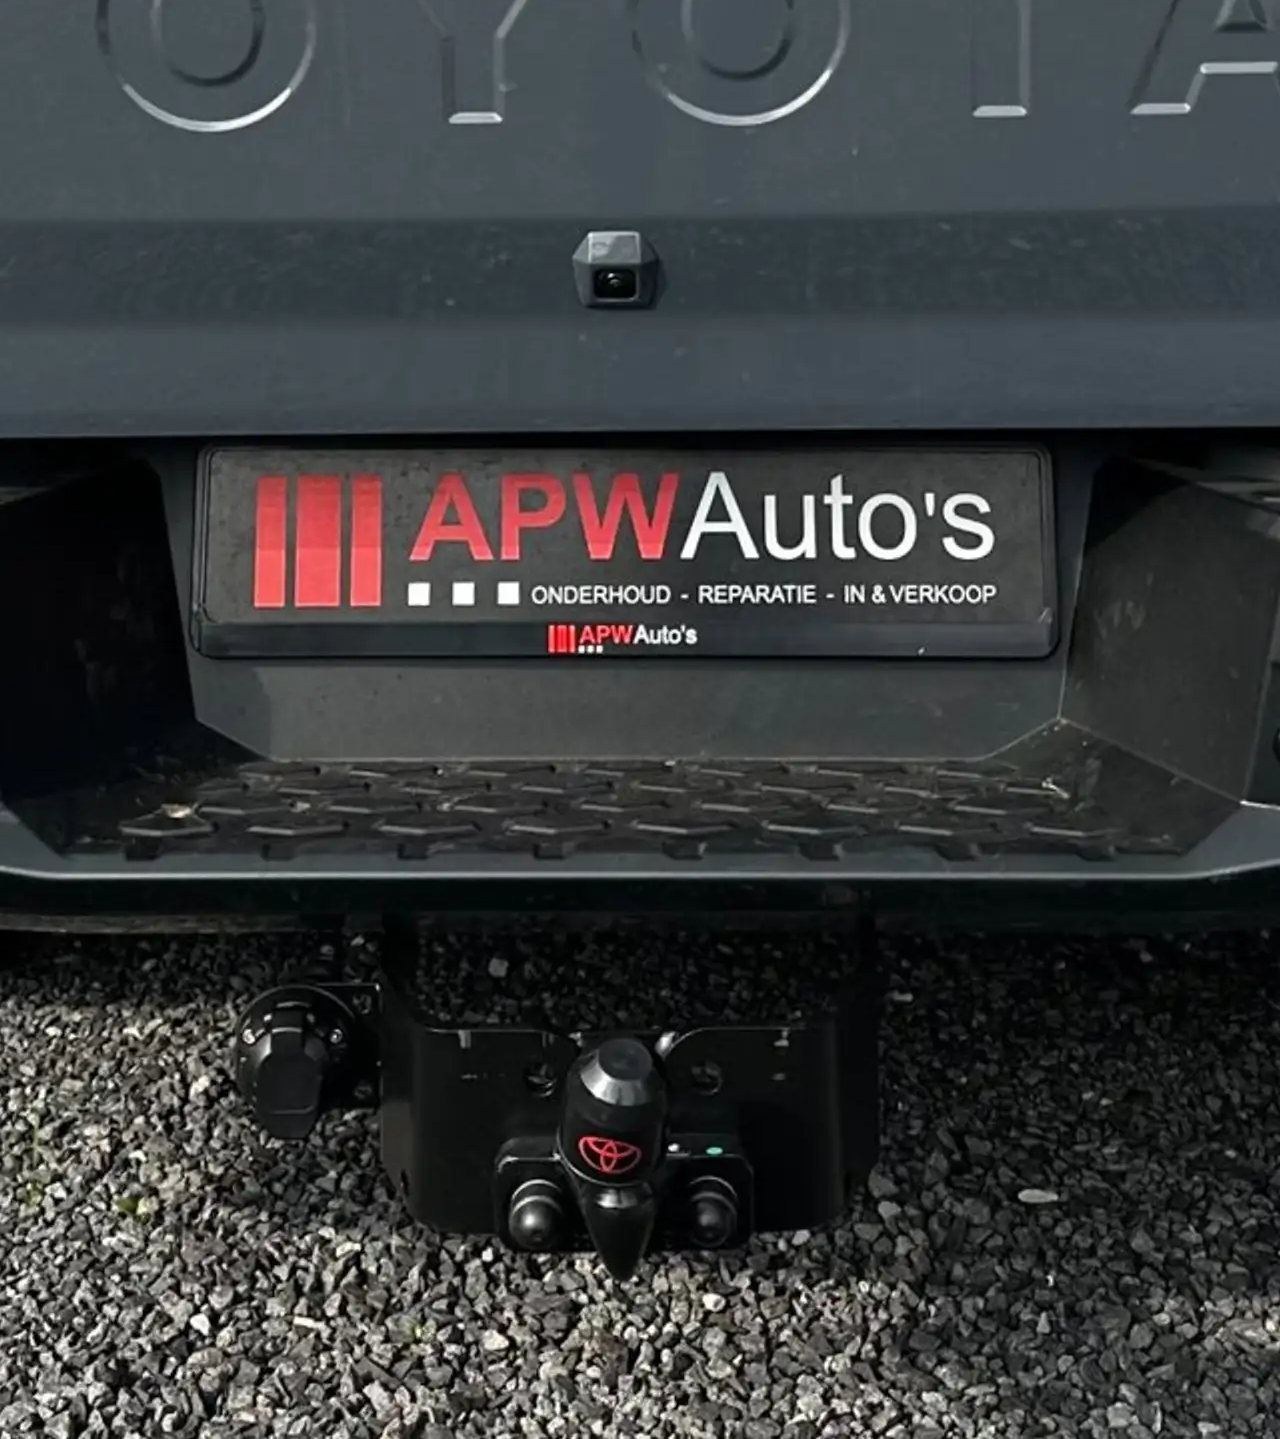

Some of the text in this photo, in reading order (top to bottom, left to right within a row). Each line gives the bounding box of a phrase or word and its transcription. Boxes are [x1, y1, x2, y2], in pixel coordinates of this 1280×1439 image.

[409, 470, 996, 560] APWAuto's
[531, 584, 671, 604] ONDERHOUD
[698, 584, 817, 603] REPARATIE
[844, 584, 866, 603] IN
